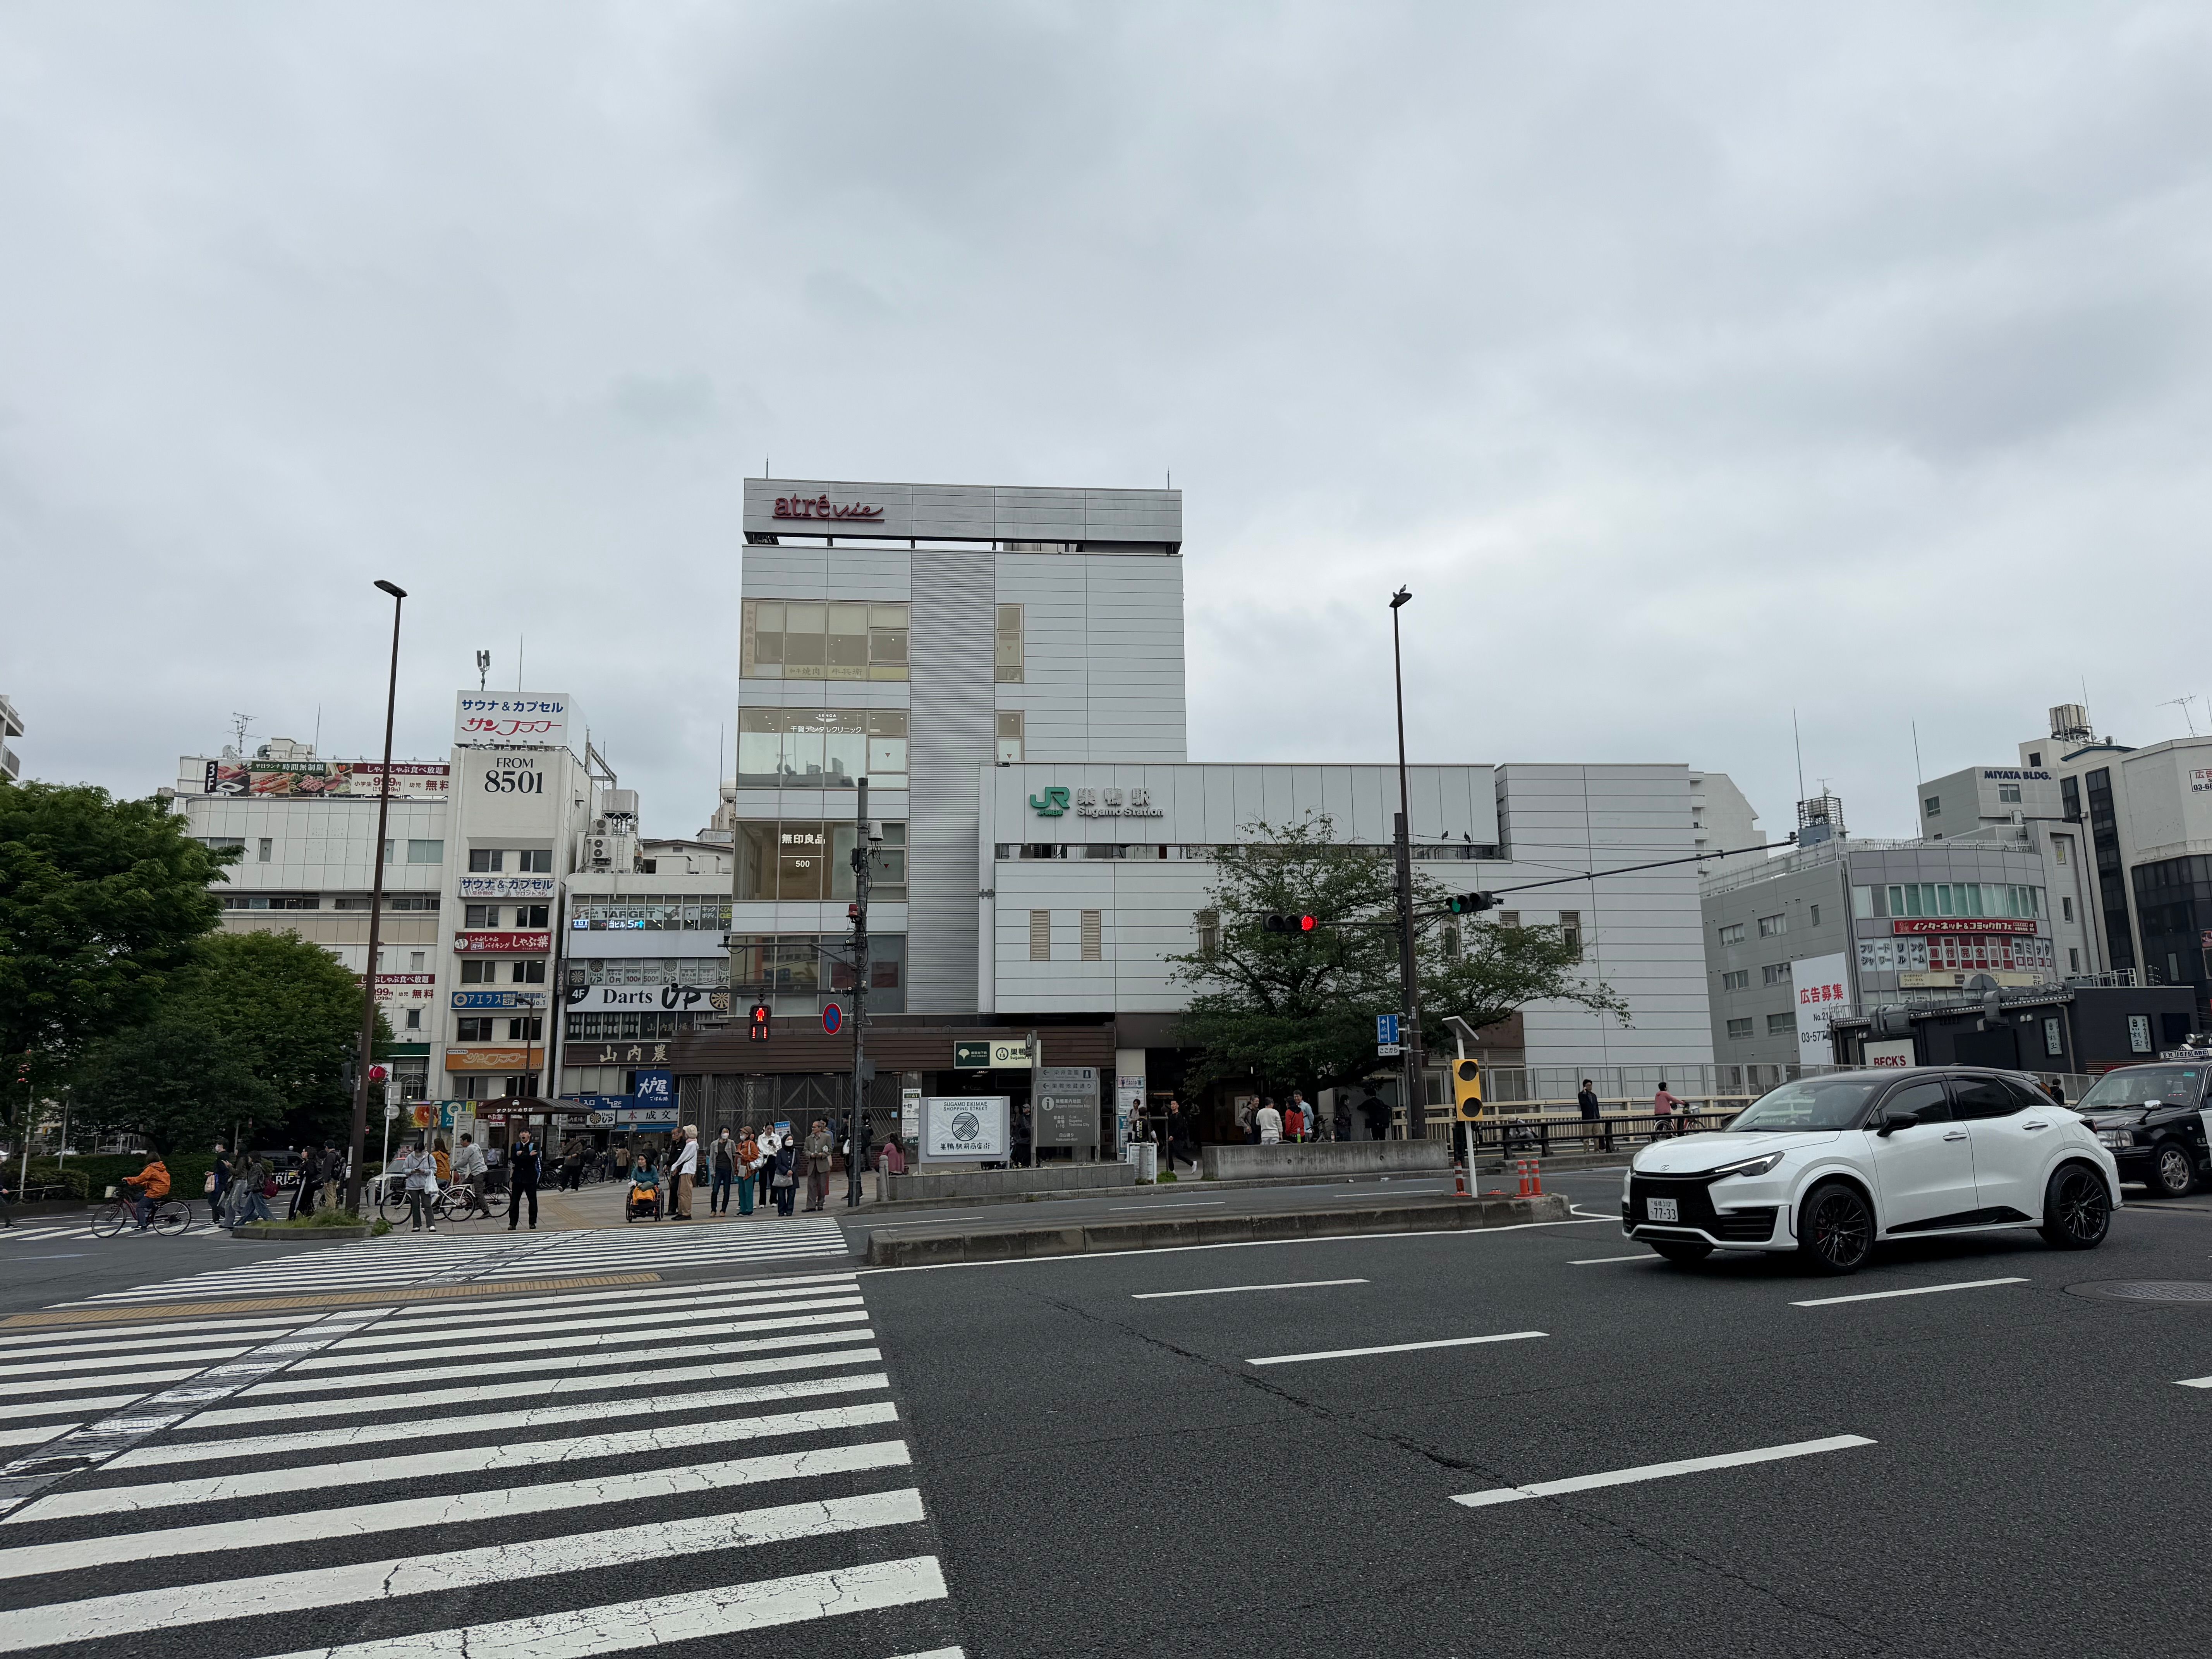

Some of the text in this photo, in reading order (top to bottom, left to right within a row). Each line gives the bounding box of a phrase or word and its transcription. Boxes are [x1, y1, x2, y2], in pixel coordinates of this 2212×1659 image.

[496, 757, 534, 769] FROM
[1984, 771, 2052, 780] MIYATA BLDG.
[373, 777, 401, 787] 99円
[425, 780, 449, 791] 無料
[484, 770, 543, 794] 8501
[1030, 787, 1070, 809] JR
[1077, 787, 1150, 805] 巣鴨駅
[1077, 806, 1164, 818] Sugamo Station
[781, 833, 825, 844] 無印良品
[609, 919, 639, 928] 当ビル 5F
[512, 935, 549, 948] しゃぶ葉
[361, 975, 429, 984] しぶしゃぶ食べ放題
[412, 989, 434, 999] 無料
[468, 994, 501, 1004] アエラス
[572, 989, 585, 999] 4F
[602, 986, 701, 1010] Darts UP
[1800, 983, 1844, 1004] 広告募集
[1874, 1055, 1906, 1066] BECK'S
[637, 1077, 669, 1098] 大戸屋
[627, 1110, 678, 1121] 本 成文
[940, 1142, 990, 1151] 巣鴨駅前商店街
